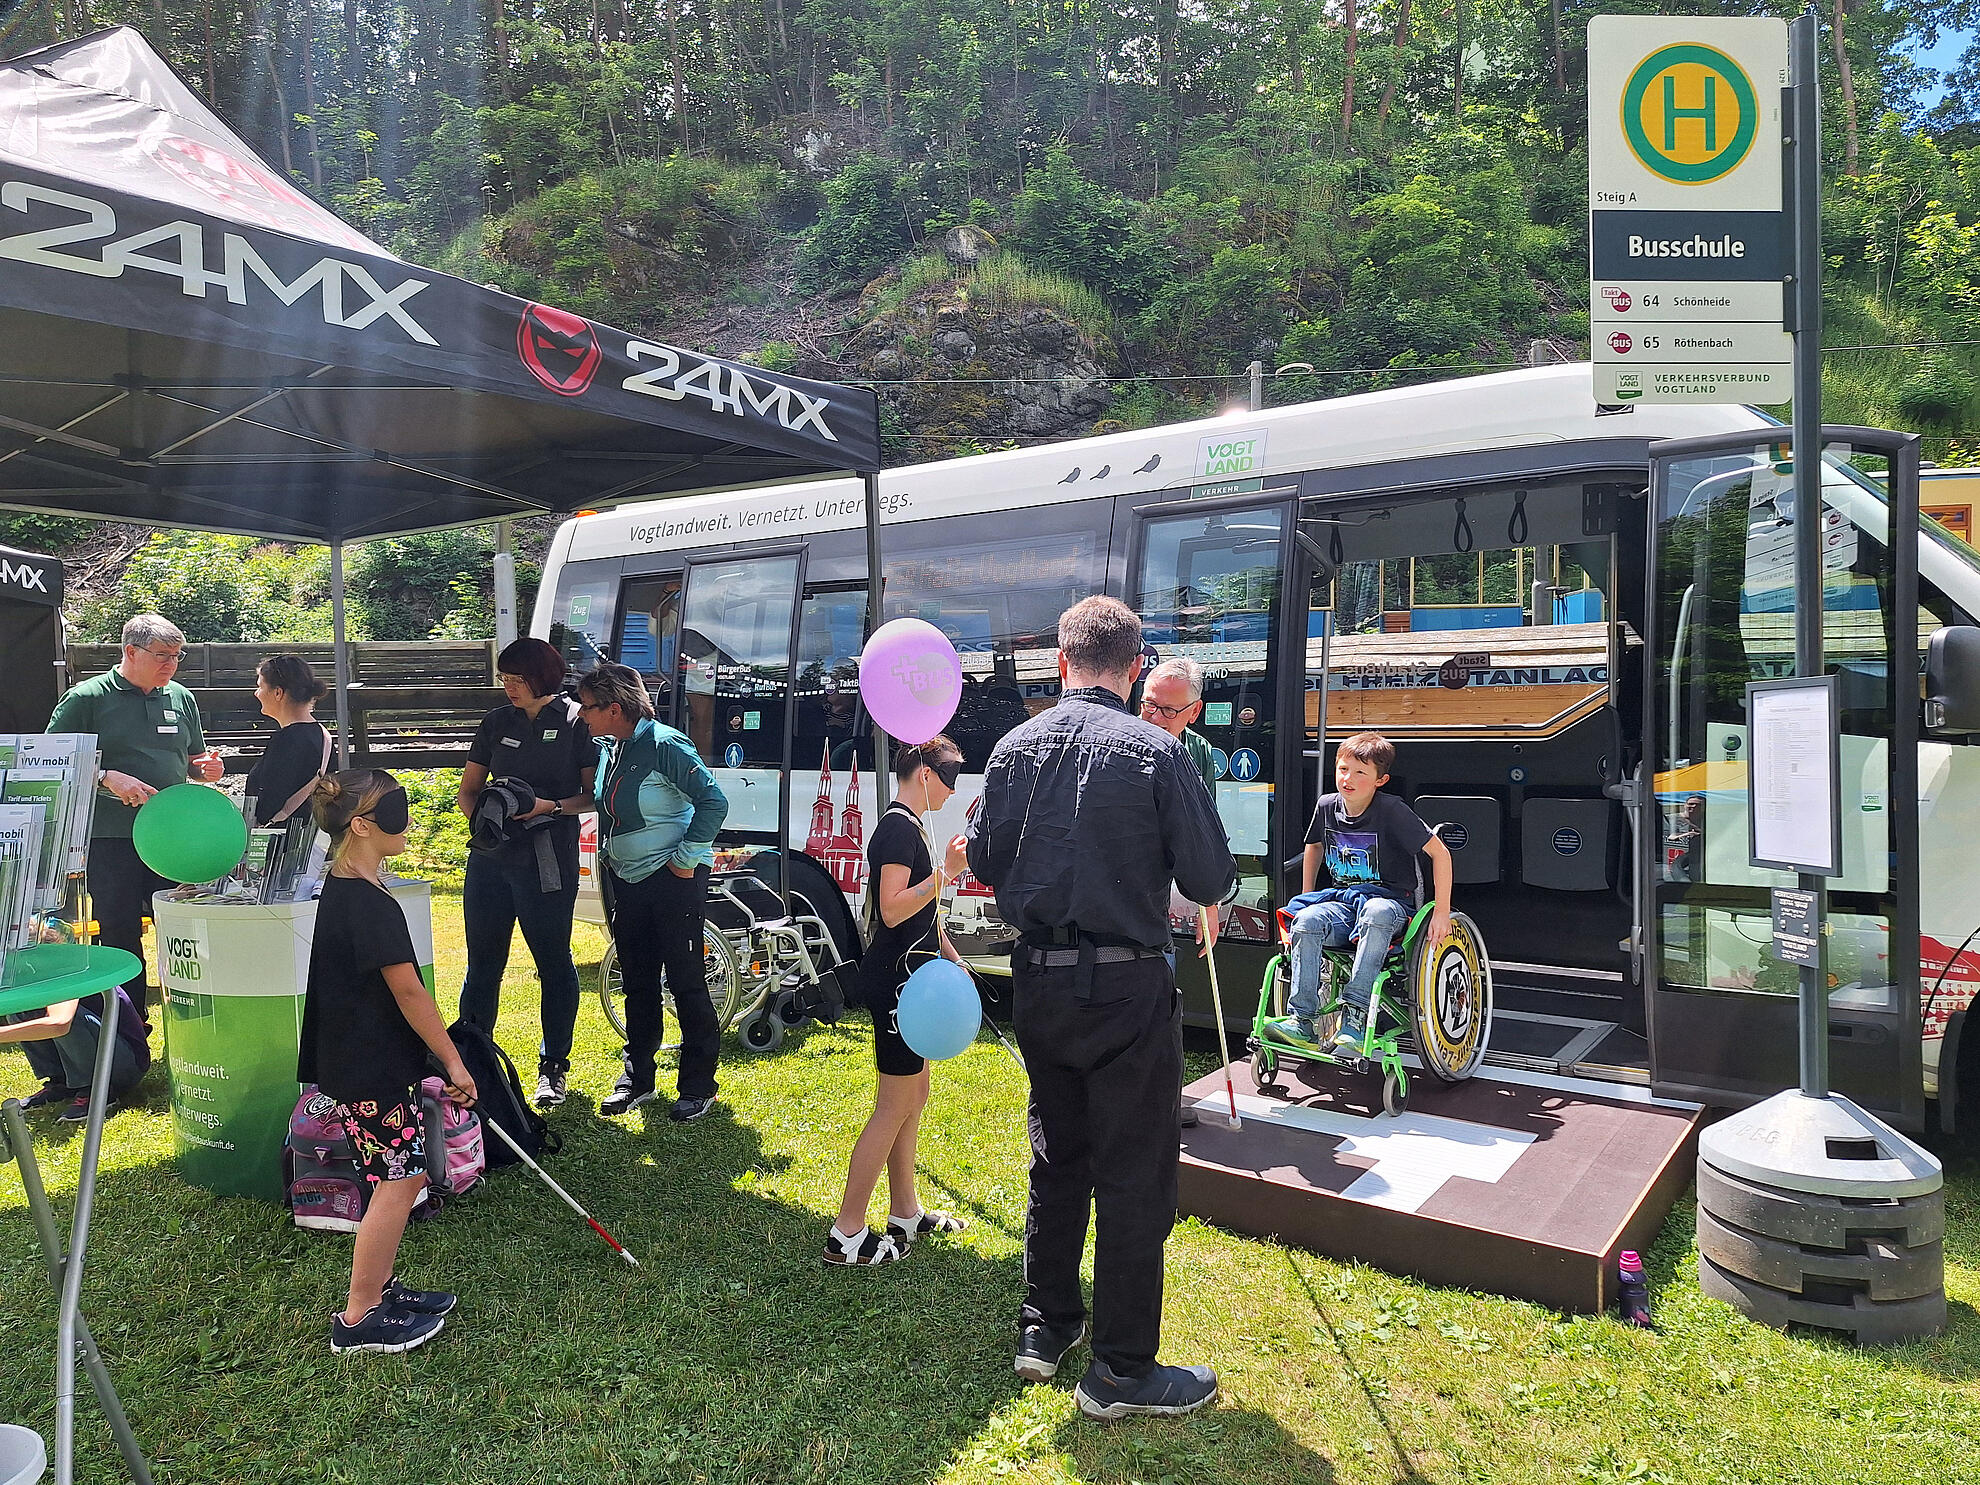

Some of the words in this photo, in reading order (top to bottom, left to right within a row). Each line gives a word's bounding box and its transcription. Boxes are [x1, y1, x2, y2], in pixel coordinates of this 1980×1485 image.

[1663, 76, 1715, 151] H
[1597, 191, 1625, 204] Steig
[1628, 192, 1637, 202] A
[1628, 234, 1745, 258] Busschule
[0, 181, 441, 347] 24MX
[1613, 298, 1630, 306] BUS
[1643, 295, 1659, 306] 64
[1673, 296, 1731, 307] Schönheide
[1613, 339, 1631, 348] BUS
[1643, 336, 1659, 348] 65
[1674, 337, 1733, 348] Röthenbach
[1655, 374, 1770, 382] VERKEHRSVERBUND
[621, 340, 839, 442] 24MX
[1655, 385, 1716, 393] VOGTLAND
[1207, 440, 1256, 459] VOGT
[1205, 456, 1253, 475] LAND
[1201, 485, 1239, 496] VERKEHR
[629, 513, 732, 544] Vogtlandweit.
[739, 503, 808, 528] Vernetzt.
[815, 492, 913, 518] Unteregs.
[0, 558, 47, 594] MX
[572, 605, 587, 616] Zug
[717, 664, 752, 675] BürgerBus
[838, 679, 860, 688] TaktB
[911, 667, 953, 692] BUS
[754, 683, 777, 692] RufBus
[42, 756, 69, 766] mobil
[166, 936, 200, 959] VOGT
[168, 957, 202, 980] LAND
